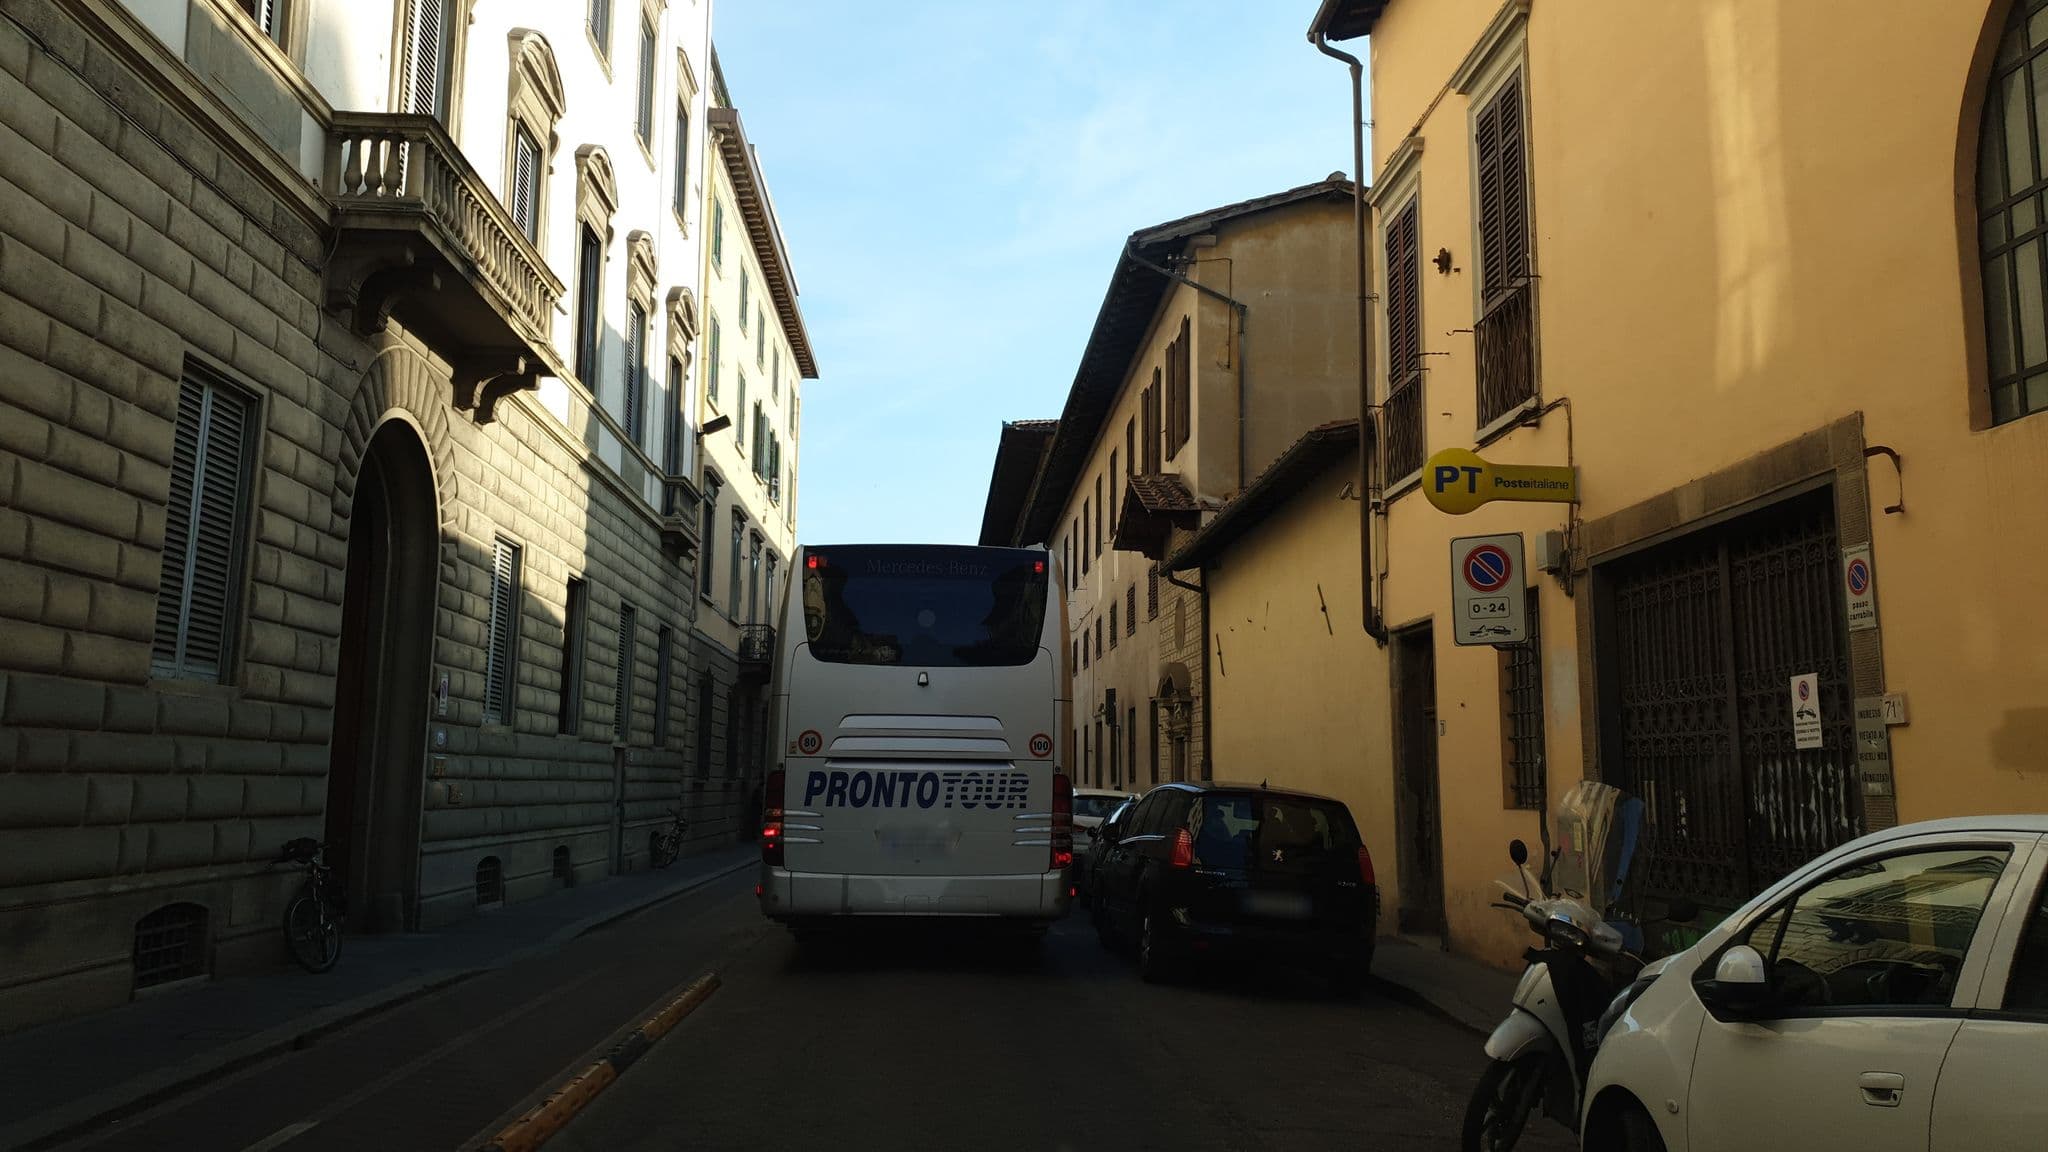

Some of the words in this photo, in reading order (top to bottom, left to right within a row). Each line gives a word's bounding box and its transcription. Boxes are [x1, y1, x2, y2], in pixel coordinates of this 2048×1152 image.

[1435, 466, 1482, 494] PT
[804, 737, 816, 748] 80
[1034, 741, 1048, 751] 100
